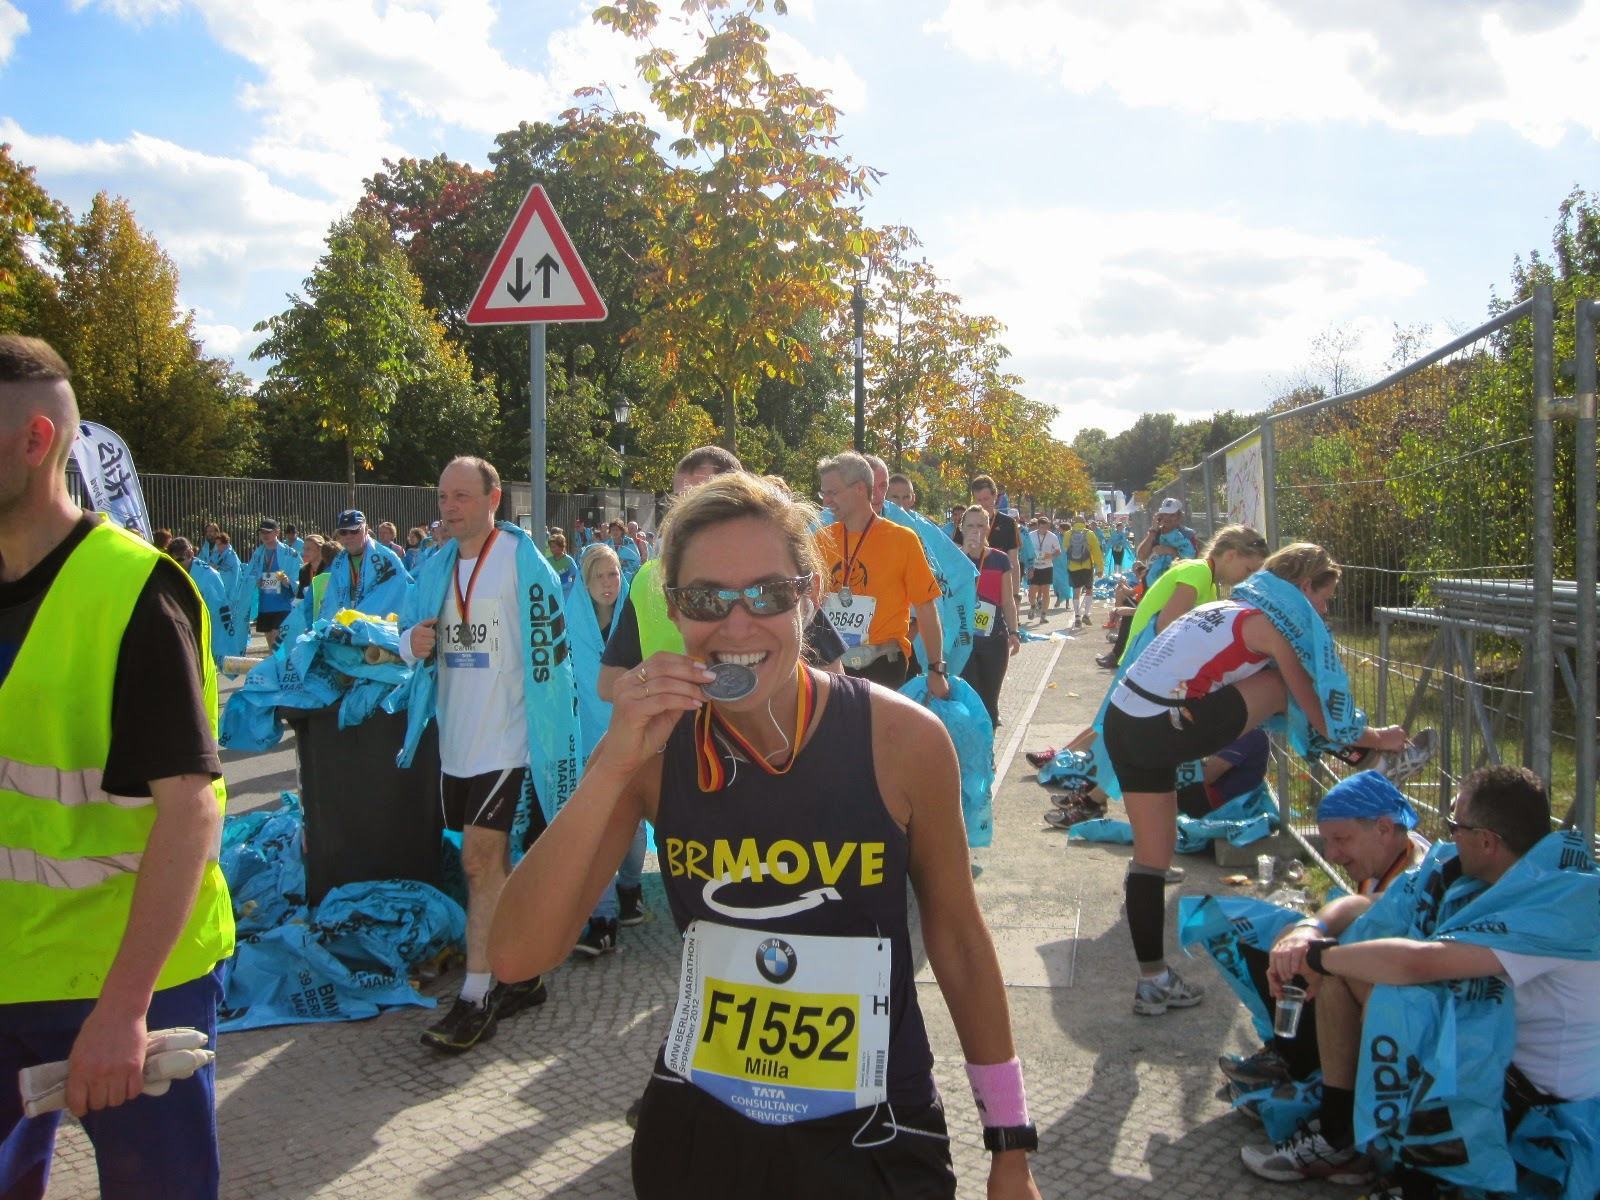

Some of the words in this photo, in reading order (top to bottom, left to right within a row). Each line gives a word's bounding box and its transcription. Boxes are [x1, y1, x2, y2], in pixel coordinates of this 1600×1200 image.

[528, 583, 551, 684] adidas
[557, 759, 568, 811] MARA
[675, 938, 695, 1041] BERLIN-MARATHON
[872, 995, 889, 1016] H
[679, 1025, 696, 1073] September
[689, 998, 699, 1021] 2012
[702, 989, 856, 1062] F1552
[670, 1044, 681, 1070] BMW
[745, 1057, 789, 1080] Milla
[731, 1095, 808, 1114] CONSULTANCY
[752, 1086, 786, 1099] TATA
[746, 1108, 795, 1123] SERVICES
